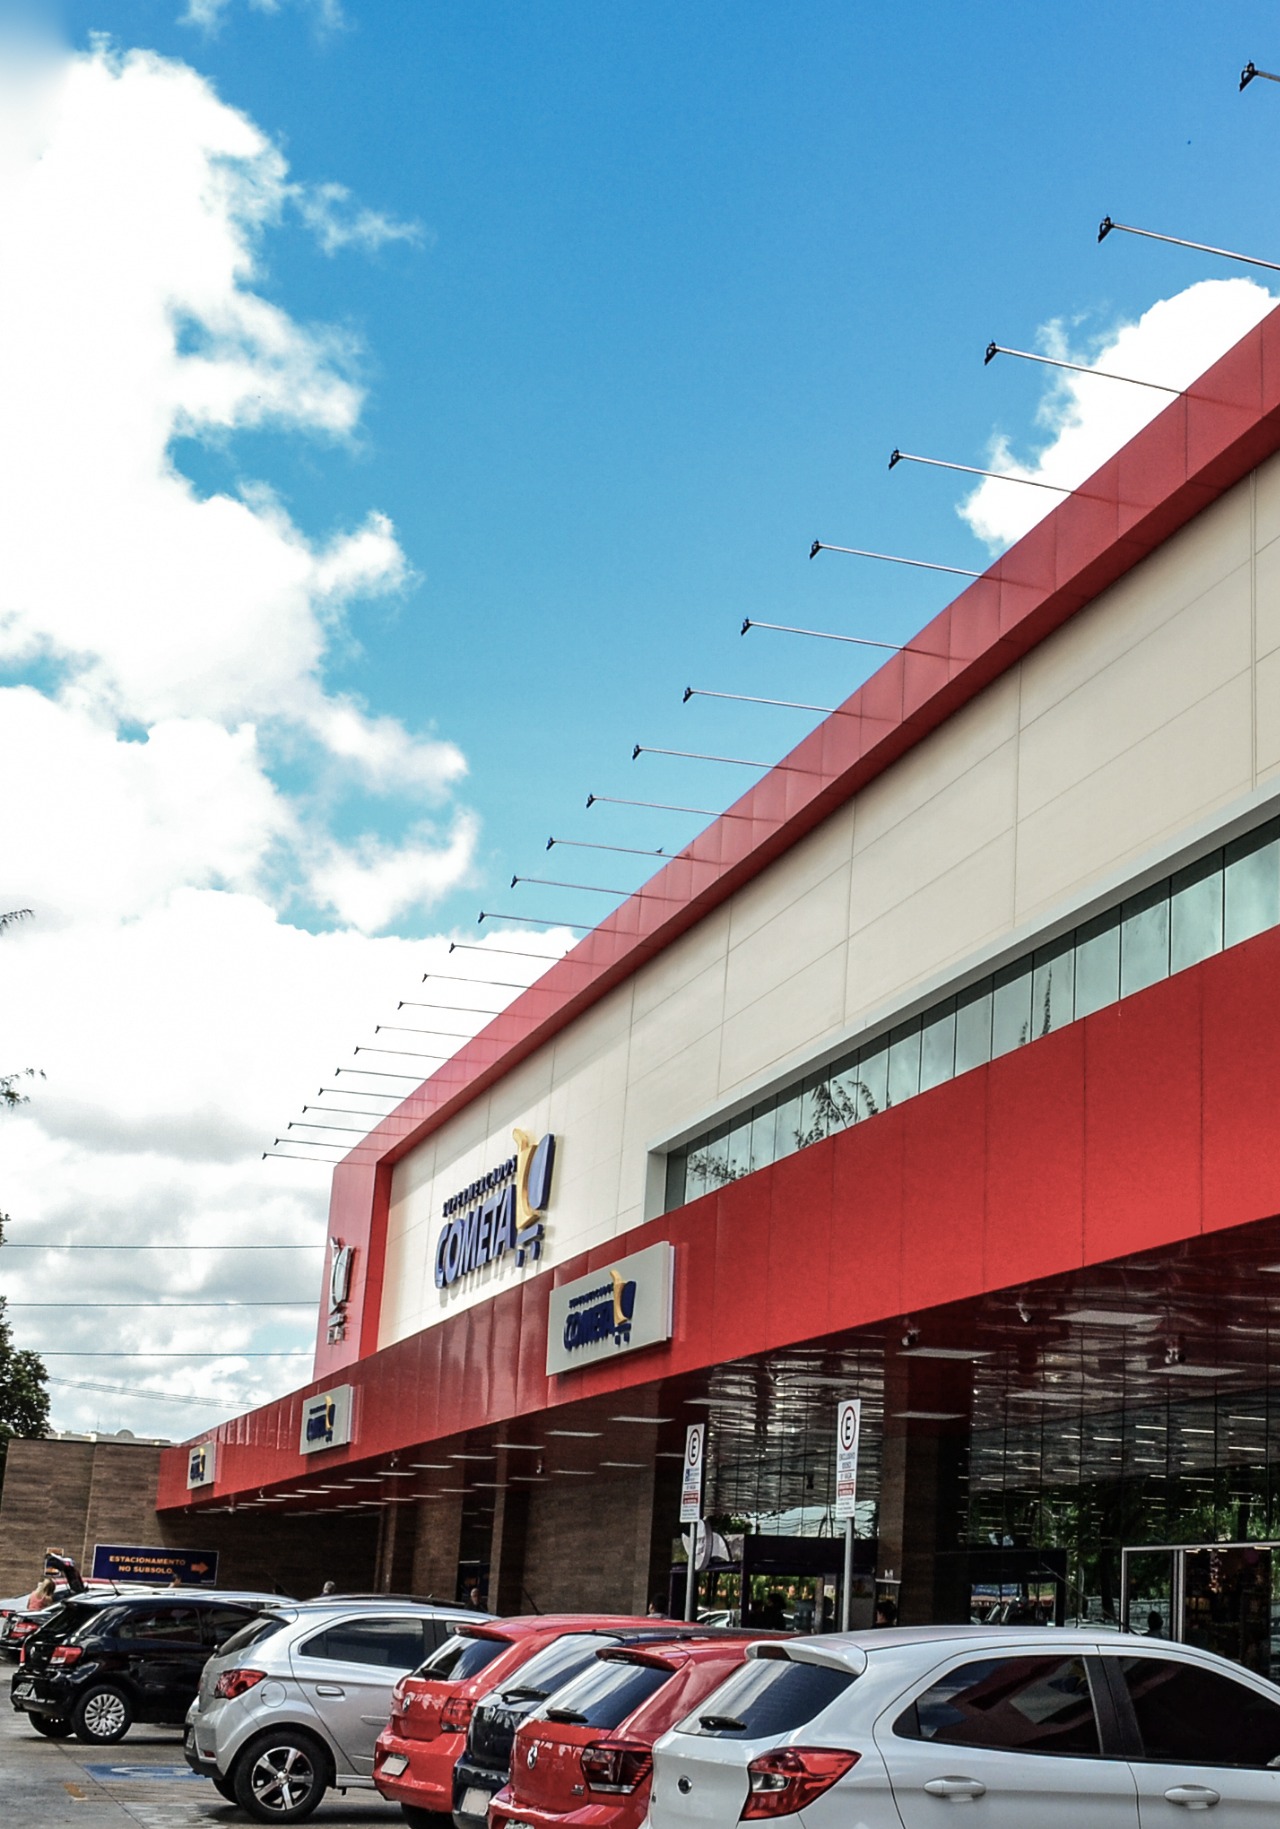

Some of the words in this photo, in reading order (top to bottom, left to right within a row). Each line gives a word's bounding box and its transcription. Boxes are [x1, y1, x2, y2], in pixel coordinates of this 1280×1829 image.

[435, 1184, 518, 1289] COMETA
[109, 1555, 186, 1566] ESTACIONAMENTO
[118, 1565, 131, 1573] NO
[133, 1566, 173, 1575] SUBSOLO
